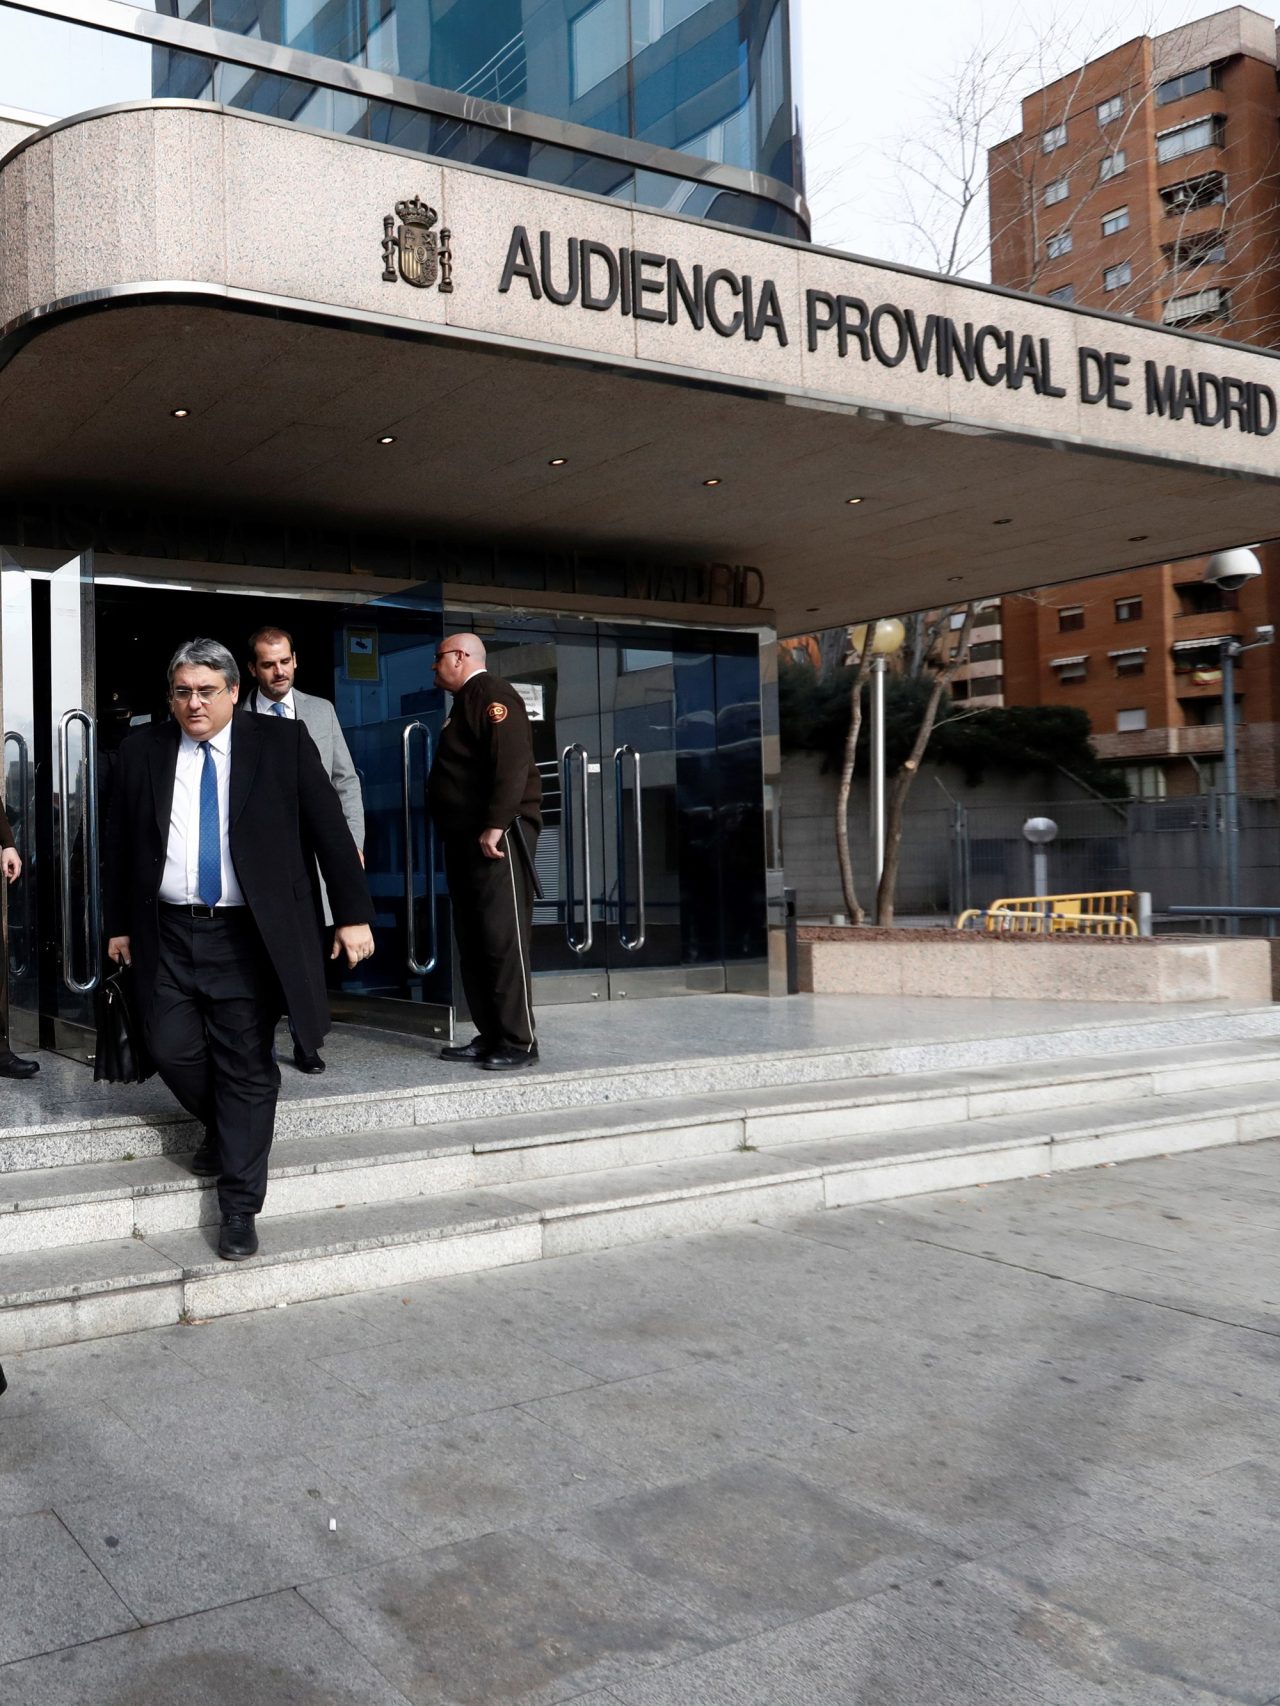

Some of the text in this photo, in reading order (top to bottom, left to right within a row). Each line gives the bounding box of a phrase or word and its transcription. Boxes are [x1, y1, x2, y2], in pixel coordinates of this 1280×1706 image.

[499, 225, 1277, 436] AUDIENCIA PROVINCIAL DE MADRID
